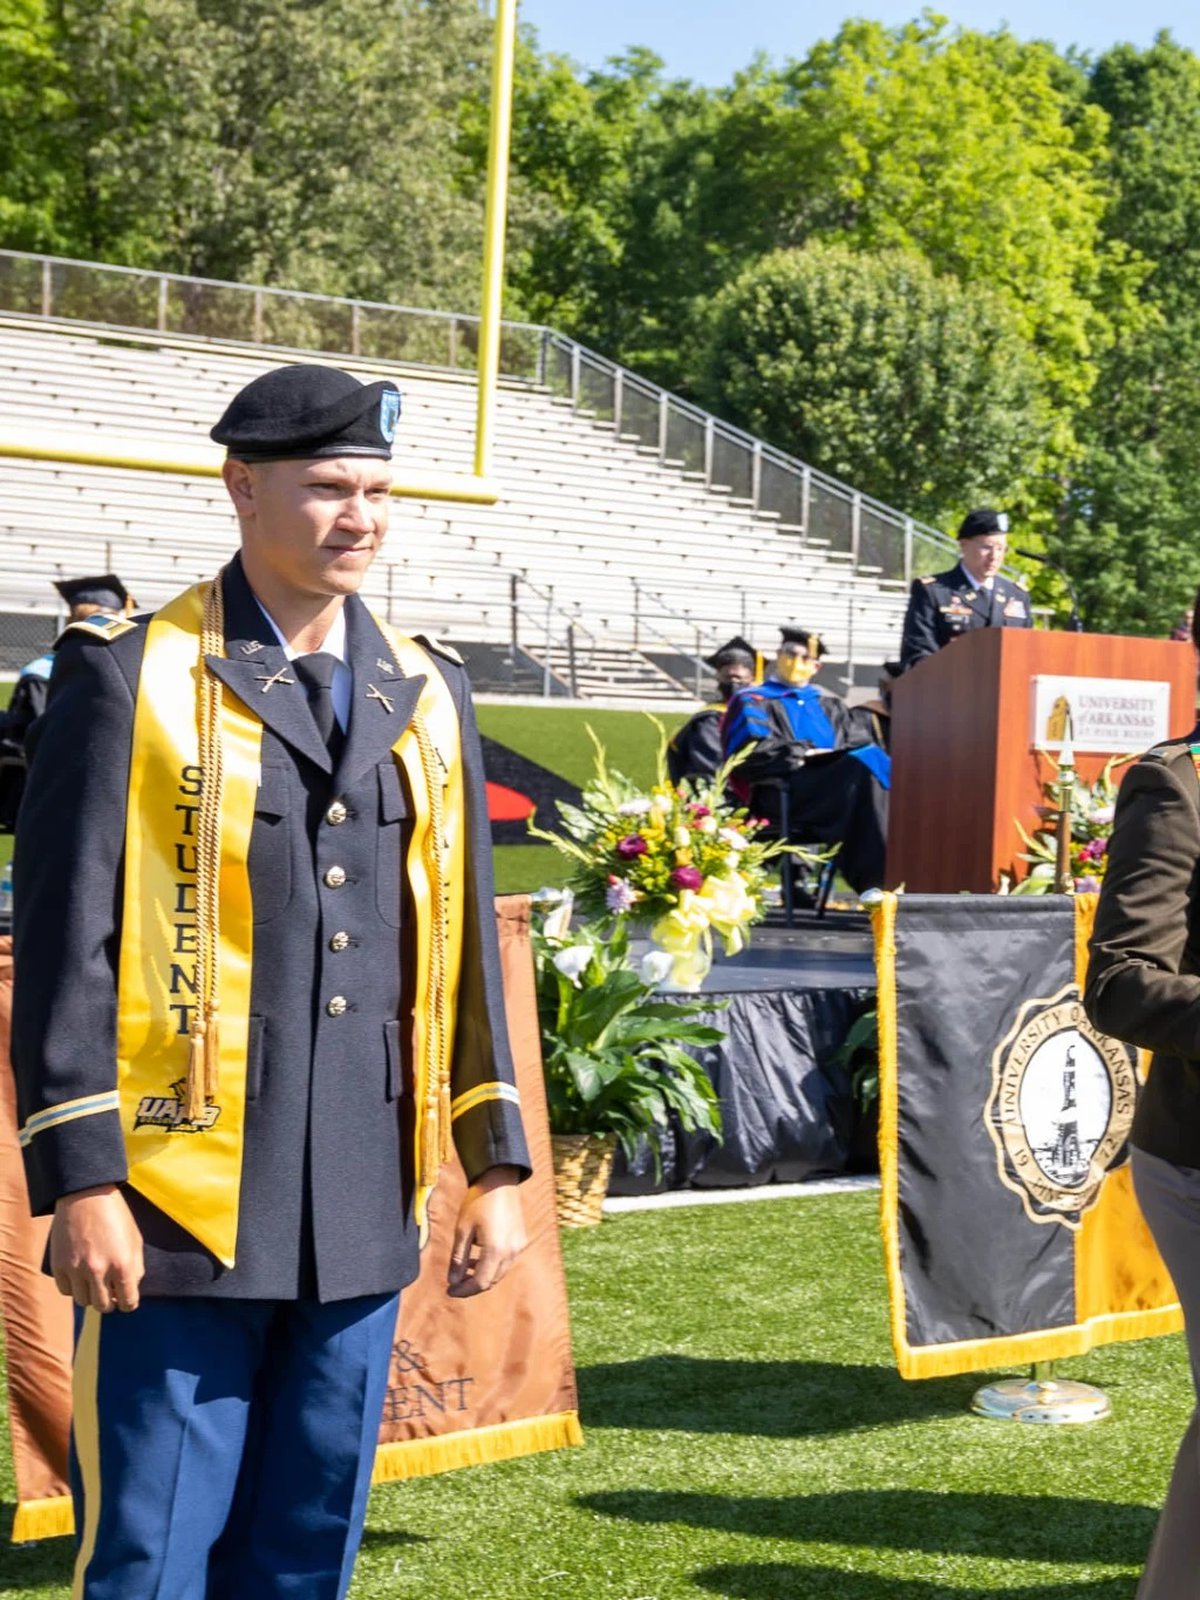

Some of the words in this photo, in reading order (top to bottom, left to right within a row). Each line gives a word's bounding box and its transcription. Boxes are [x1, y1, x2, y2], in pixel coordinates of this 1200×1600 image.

[240, 640, 264, 655] US
[1078, 695, 1156, 711] UNIVERSITY
[1089, 711, 1155, 727] ARKANSAS
[168, 765, 201, 1035] STUDENT
[392, 1340, 425, 1373] &
[386, 1377, 474, 1422] ENT
